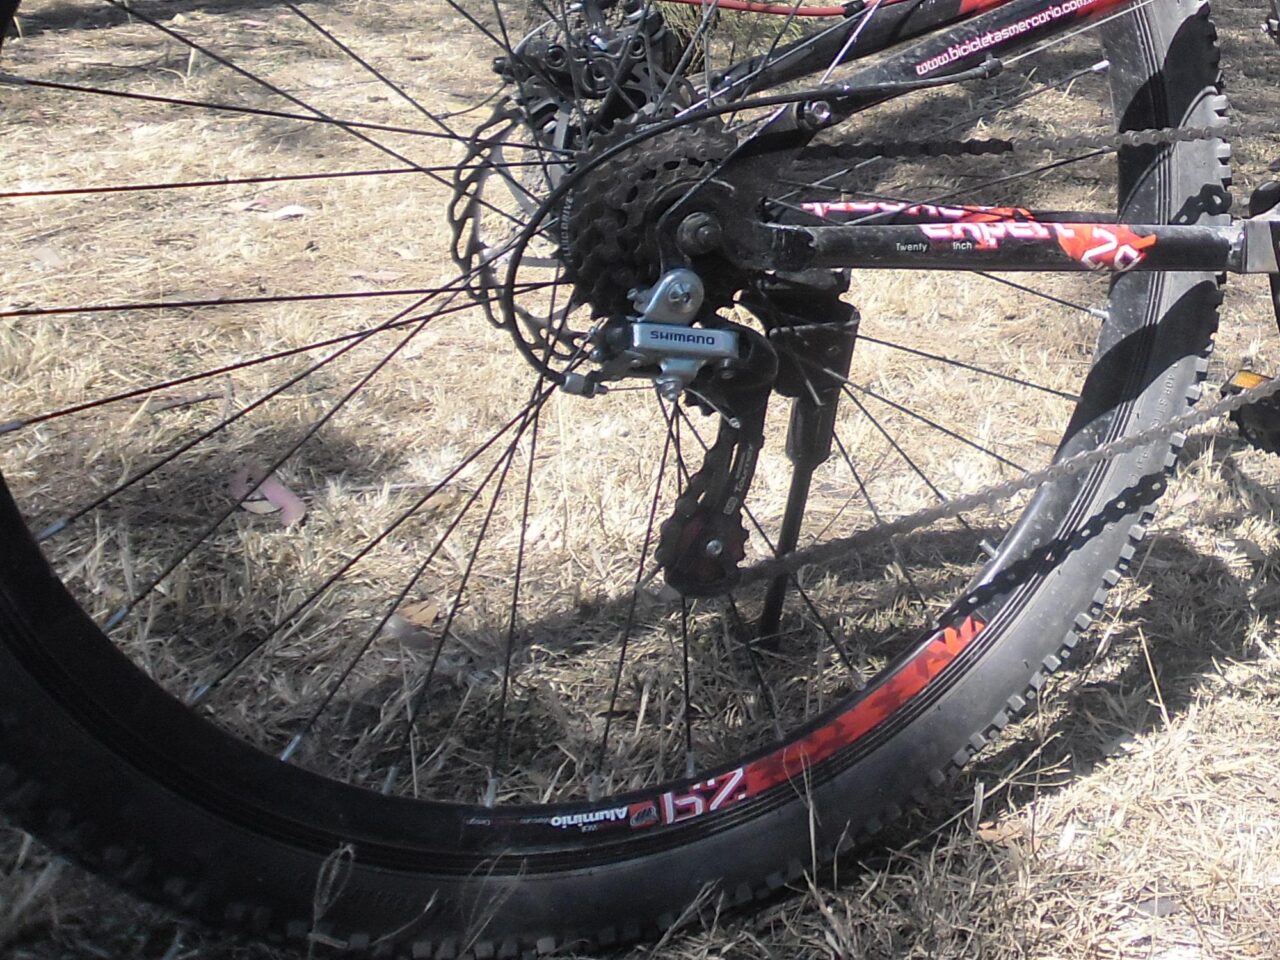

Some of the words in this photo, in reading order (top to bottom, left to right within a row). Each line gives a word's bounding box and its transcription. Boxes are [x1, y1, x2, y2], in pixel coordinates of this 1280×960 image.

[896, 243, 927, 252] Twenty
[650, 330, 715, 345] SHIMANO
[551, 806, 628, 827] Aluminio
